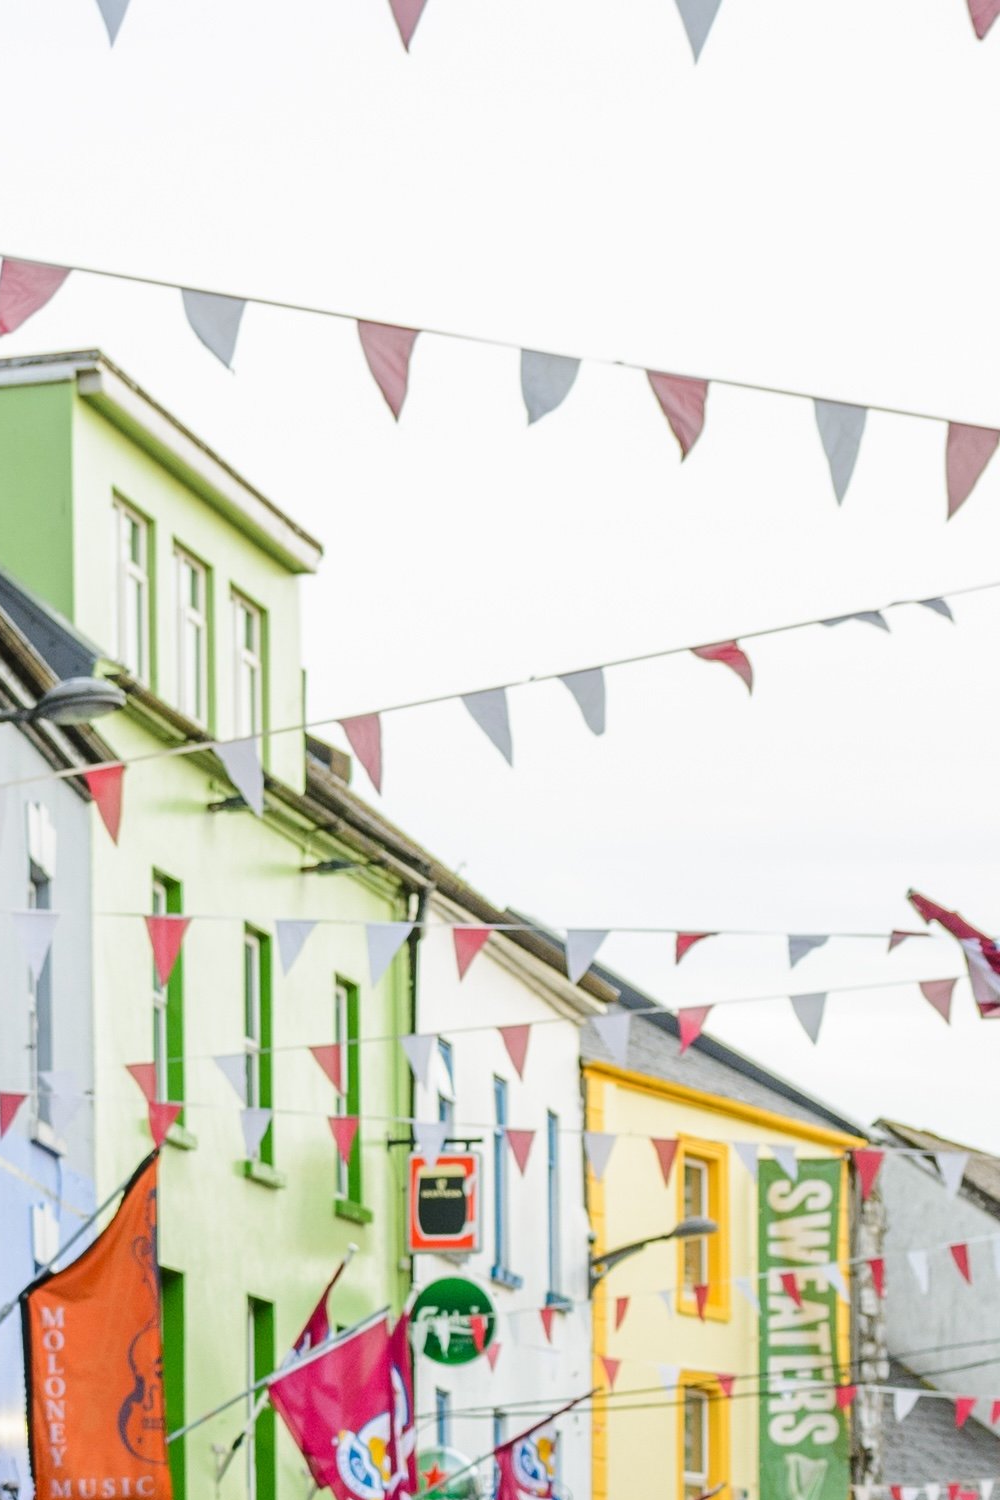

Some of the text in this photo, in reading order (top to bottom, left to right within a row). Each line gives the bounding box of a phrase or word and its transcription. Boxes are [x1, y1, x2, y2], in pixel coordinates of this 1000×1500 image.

[39, 1306, 69, 1471] MOLONEY
[768, 1179, 840, 1447] SWEATERS
[50, 1475, 157, 1499] MUSIC
